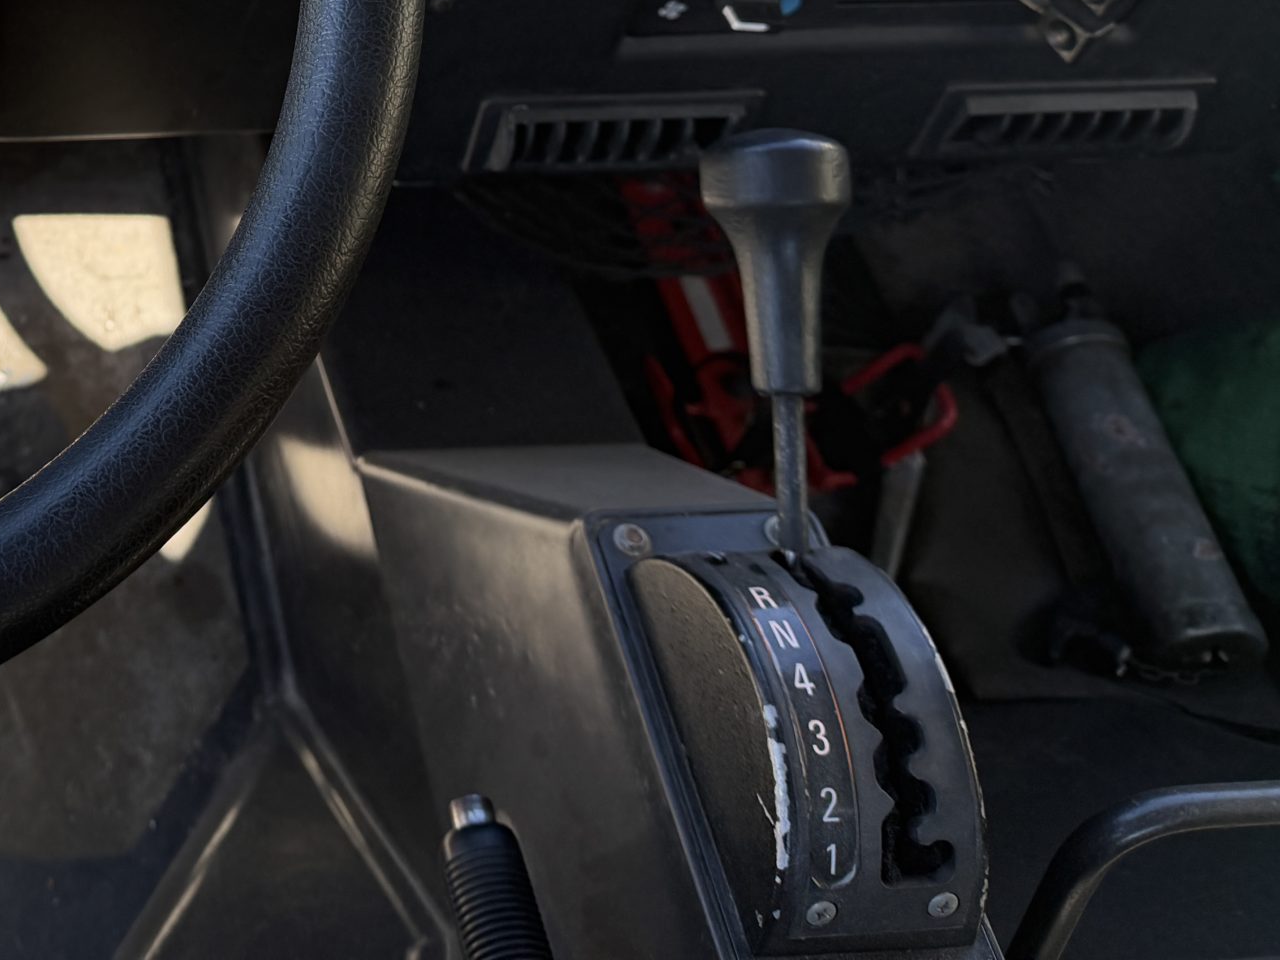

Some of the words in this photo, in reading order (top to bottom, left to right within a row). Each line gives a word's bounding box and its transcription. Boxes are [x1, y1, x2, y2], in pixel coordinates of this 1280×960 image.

[748, 586, 778, 610] R
[769, 619, 801, 650] N
[793, 662, 817, 696] 4
[808, 719, 831, 757] 3
[819, 787, 841, 823] 2
[825, 843, 838, 876] 1
